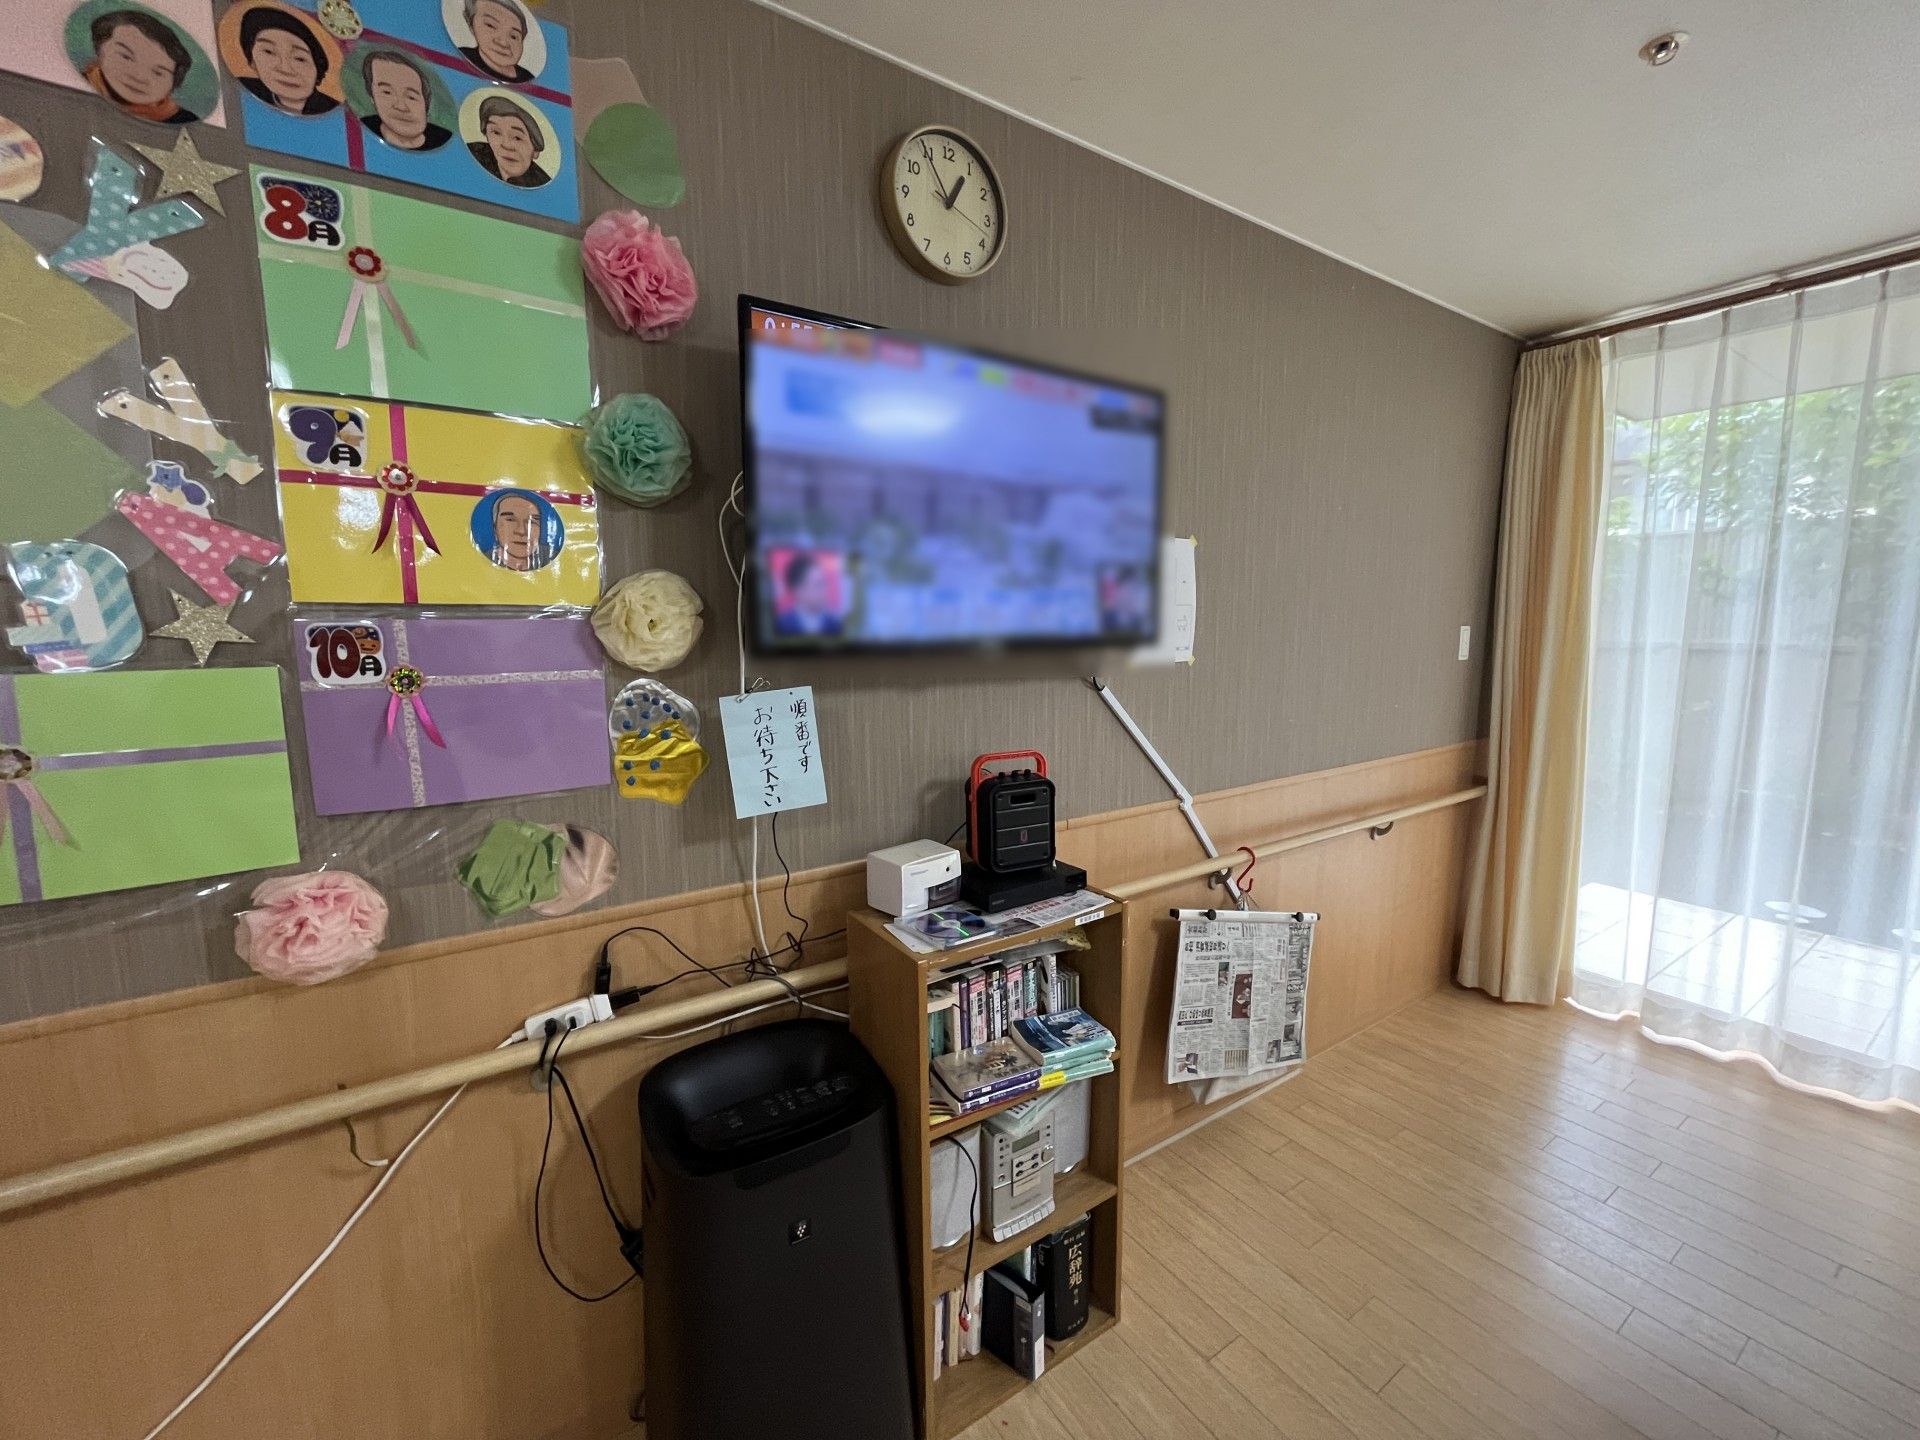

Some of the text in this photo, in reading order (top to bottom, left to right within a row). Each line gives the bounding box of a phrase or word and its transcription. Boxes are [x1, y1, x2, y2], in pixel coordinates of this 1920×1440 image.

[923, 145, 933, 161] 11
[943, 146, 955, 162] 12
[908, 160, 920, 175] 10
[967, 163, 972, 176] 1
[902, 185, 910, 198] 9
[980, 188, 988, 201] 2
[264, 184, 340, 246] 8月
[907, 213, 915, 227] 8
[984, 215, 991, 227] 3
[923, 238, 931, 252] 7
[979, 238, 986, 251] 4
[943, 252, 951, 266] 6
[964, 252, 971, 265] 5
[289, 408, 362, 467] 9月
[309, 628, 383, 679] 10月
[790, 698, 812, 774] 順番です
[753, 706, 782, 807] お待ち下さい
